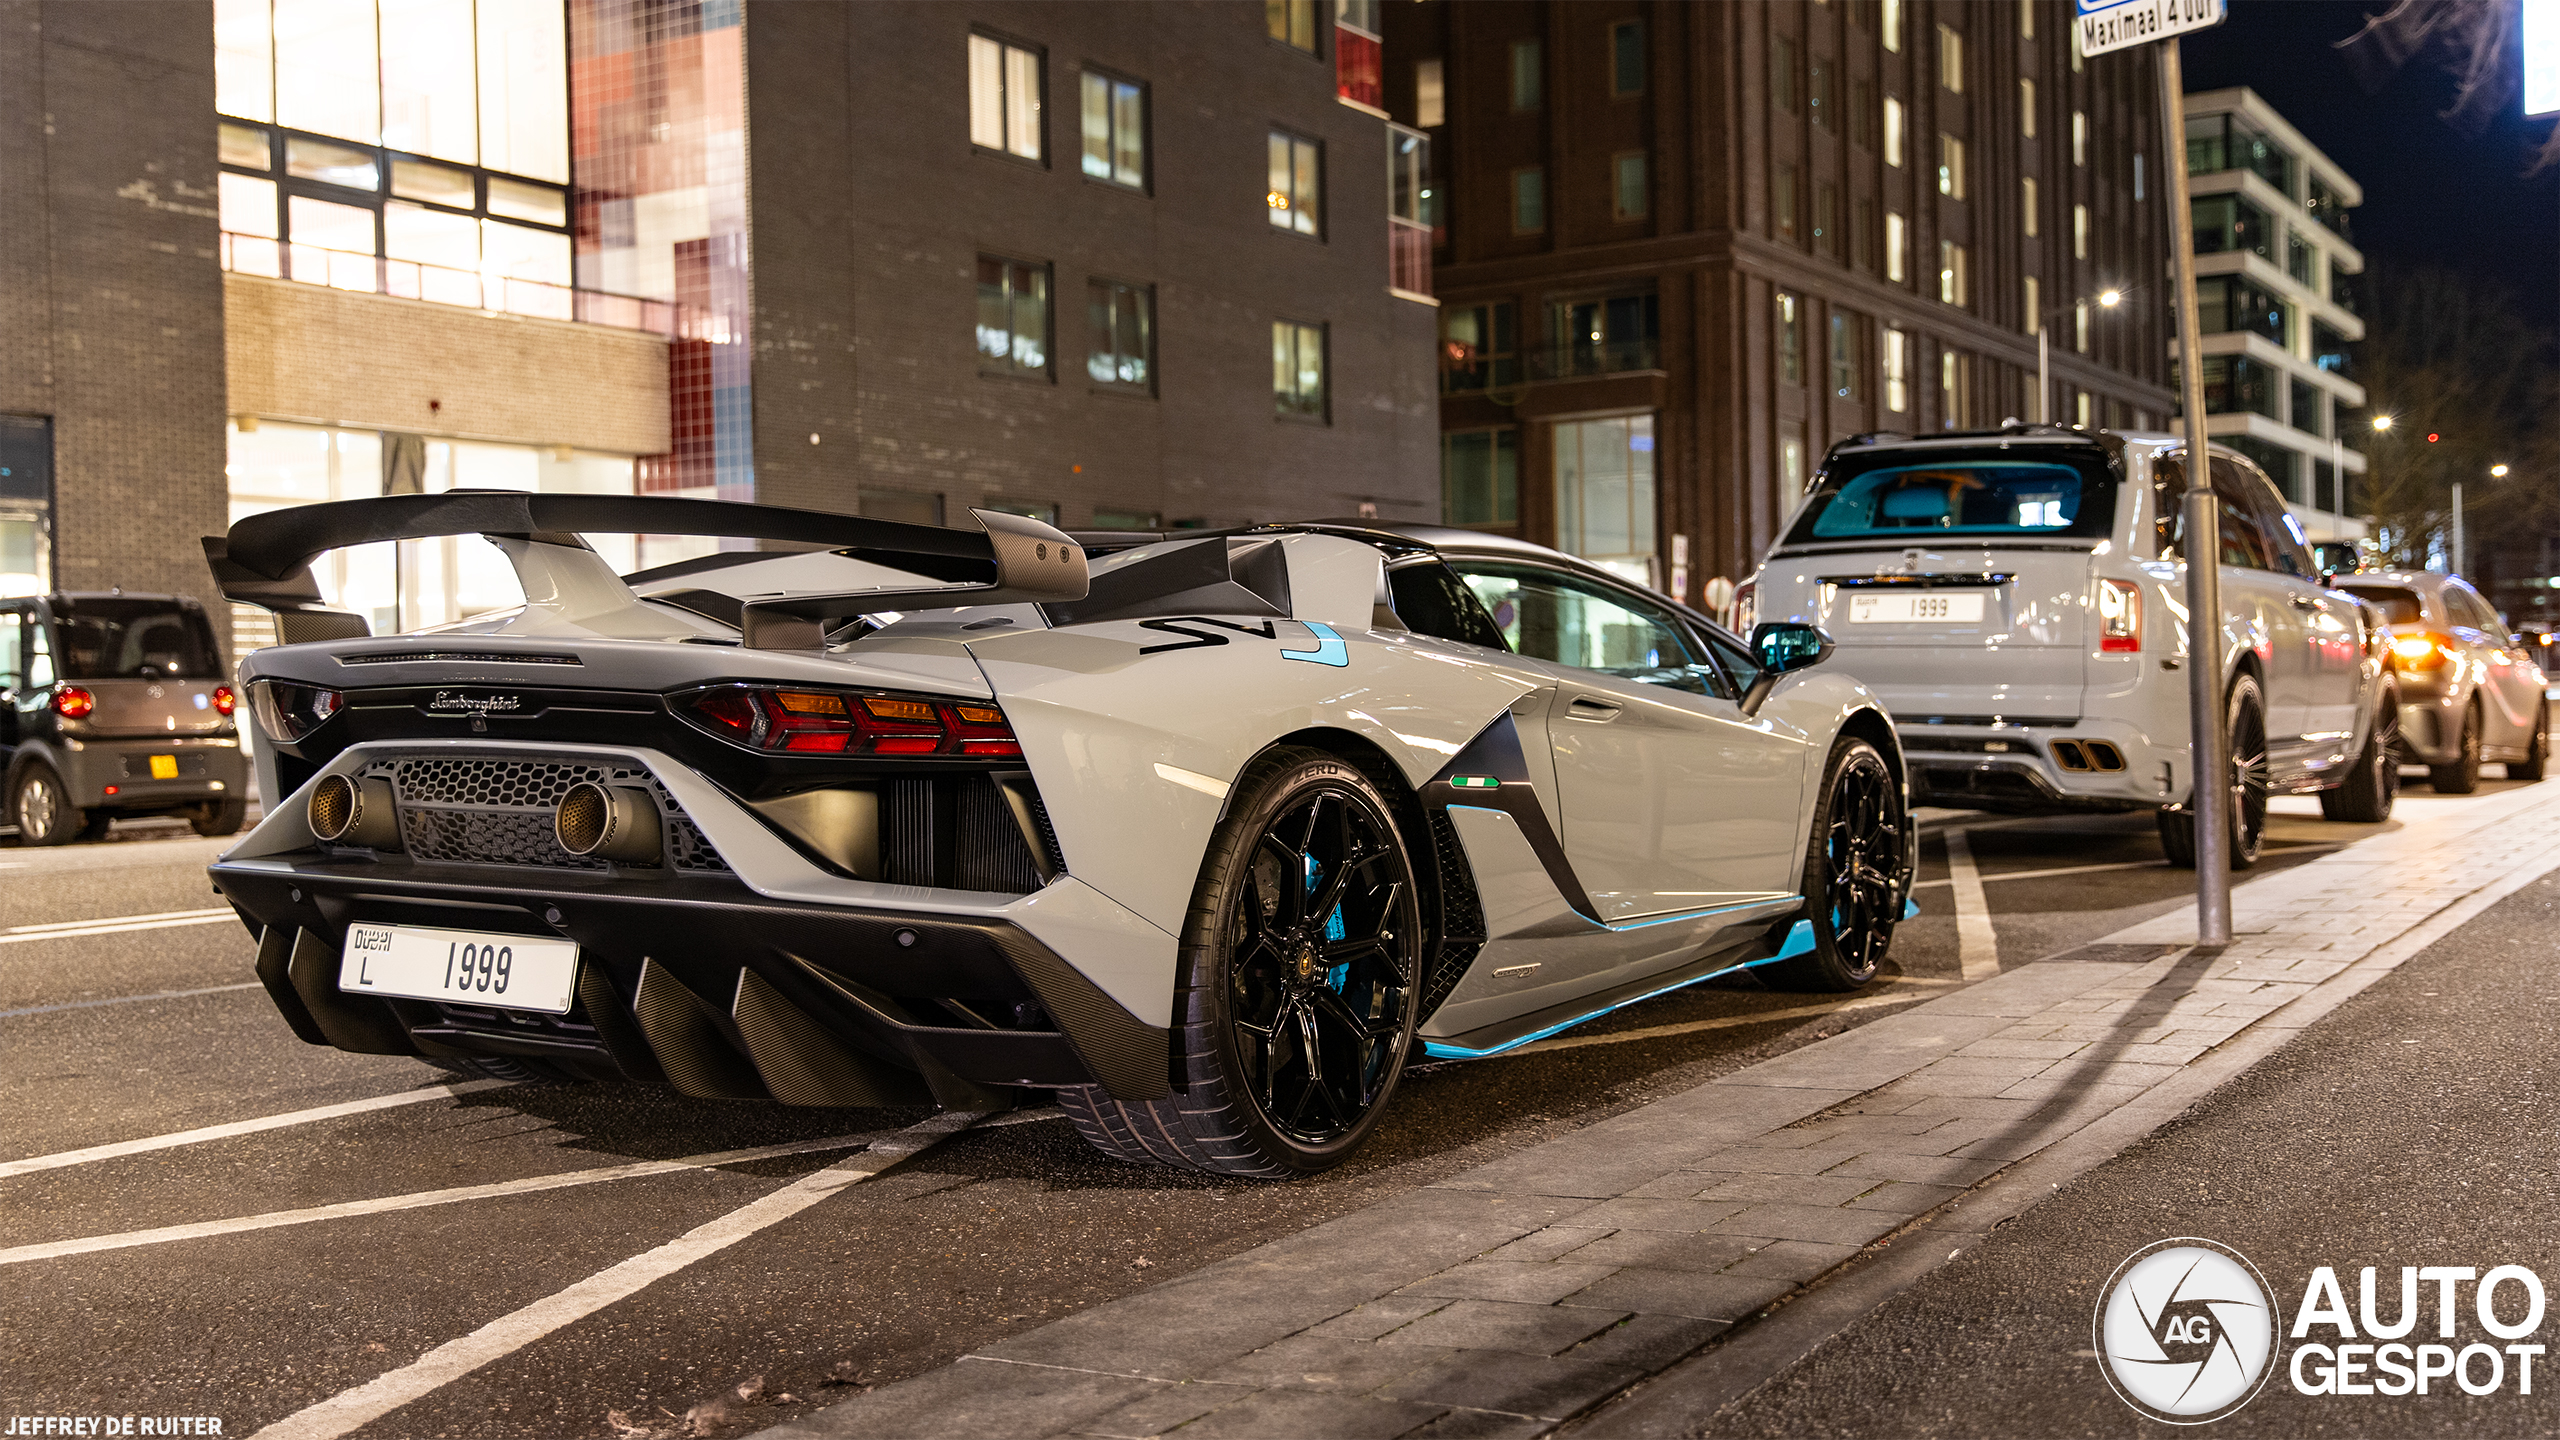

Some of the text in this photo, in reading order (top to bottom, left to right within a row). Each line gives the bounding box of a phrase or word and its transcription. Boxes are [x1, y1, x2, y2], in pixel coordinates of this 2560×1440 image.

[2083, 0, 2163, 51] Maximaal
[2167, 0, 2179, 27] 4
[1910, 598, 1948, 618] 1999
[1139, 616, 1349, 668] SVJ
[429, 691, 521, 717] Lamborghini
[1293, 764, 1339, 785] ZERO
[359, 956, 374, 986] L
[444, 941, 513, 995] 1999
